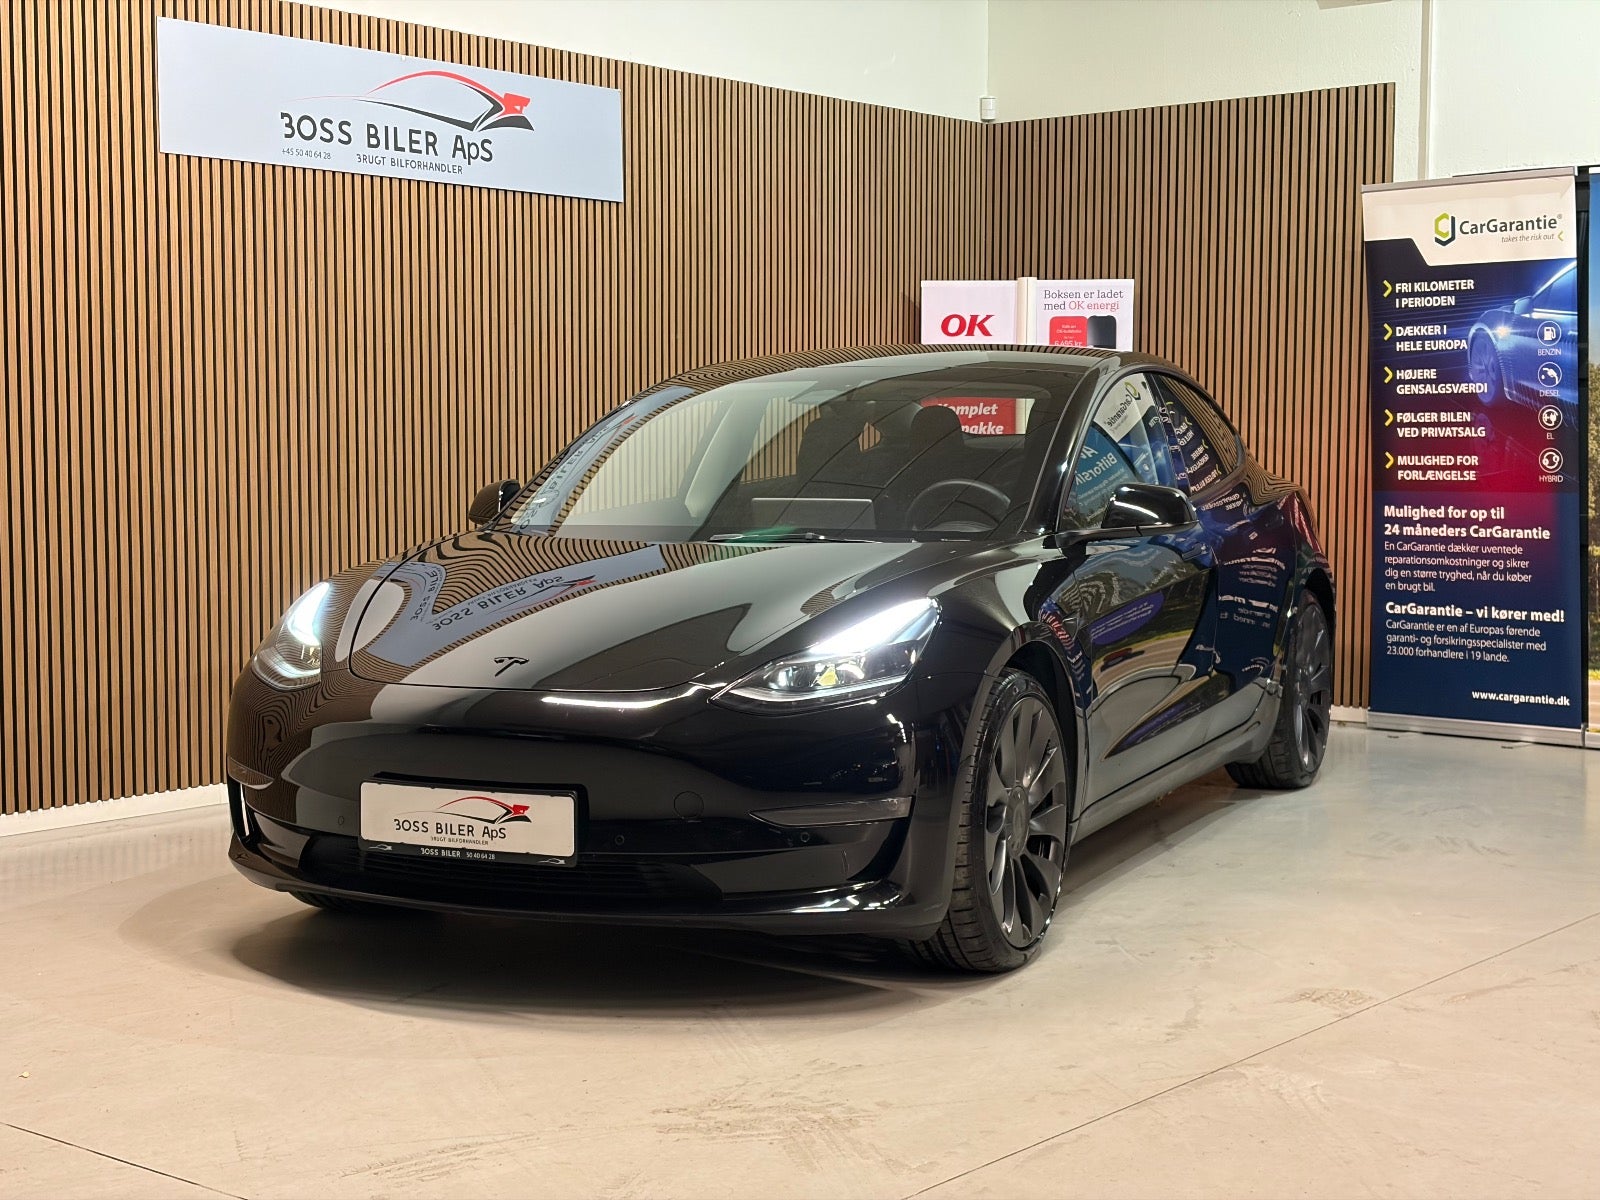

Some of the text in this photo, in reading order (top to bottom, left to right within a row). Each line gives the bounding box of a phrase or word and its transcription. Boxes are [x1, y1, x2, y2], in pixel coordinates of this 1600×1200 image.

[367, 124, 438, 157] BILER
[452, 134, 493, 165] ApS
[295, 149, 303, 157] 50
[304, 149, 312, 159] 40
[314, 151, 322, 159] 64
[323, 152, 331, 160] 28
[390, 157, 463, 174] BILFORHANDLER
[1396, 280, 1474, 294] FRI KILOMETER
[1044, 290, 1081, 300] Boksen
[1097, 290, 1123, 299] ladet
[1044, 301, 1120, 312] med OK energi
[1396, 296, 1455, 308] I PERIODEN
[941, 314, 995, 337] OK
[1396, 325, 1446, 337] DÆKKER I
[1396, 339, 1467, 352] HELE EUROPA
[1538, 348, 1562, 356] BENZIN
[1396, 369, 1437, 380] HØJERE
[1397, 383, 1488, 395] GENSALGSVÆRDI
[938, 403, 998, 416] omplet
[1397, 412, 1471, 423] FØLGER BILEN
[1397, 427, 1485, 438] VED PRIVATSALG
[1398, 456, 1478, 466] MULIGHED FOR
[1398, 470, 1476, 481] FORLÆNGELSE
[1539, 475, 1563, 483] HYBRID
[1384, 506, 1504, 521] Mulighed for op til
[1384, 523, 1550, 539] 24 måneders CarGarantie
[1385, 542, 1523, 555] En CarGarantie dækker uventede
[1385, 556, 1529, 569] reparationsomkostninger og sikrer
[1385, 569, 1398, 579] dig
[1413, 570, 1437, 579] større
[1477, 572, 1490, 581] når
[1493, 573, 1504, 581] du
[1506, 573, 1532, 582] køber
[1398, 583, 1421, 593] brugt
[1386, 602, 1462, 617] CarGarantie
[1476, 607, 1488, 619] vi
[1491, 607, 1528, 621] kører
[1530, 610, 1565, 622] med!
[1386, 620, 1434, 631] CarGarantie
[1460, 624, 1468, 632] af
[1470, 624, 1504, 636] Europas
[1506, 626, 1540, 637] førende
[1387, 635, 1546, 651] garanti- og forsikringsspecialister med
[1387, 646, 1413, 656] 23.000
[1416, 647, 1463, 659] forhandlere
[1471, 651, 1481, 660] 19
[1472, 690, 1570, 706] www.cargarantie.dk
[436, 823, 474, 837] BILER
[482, 826, 506, 840] ApS
[441, 849, 461, 858] BILER
